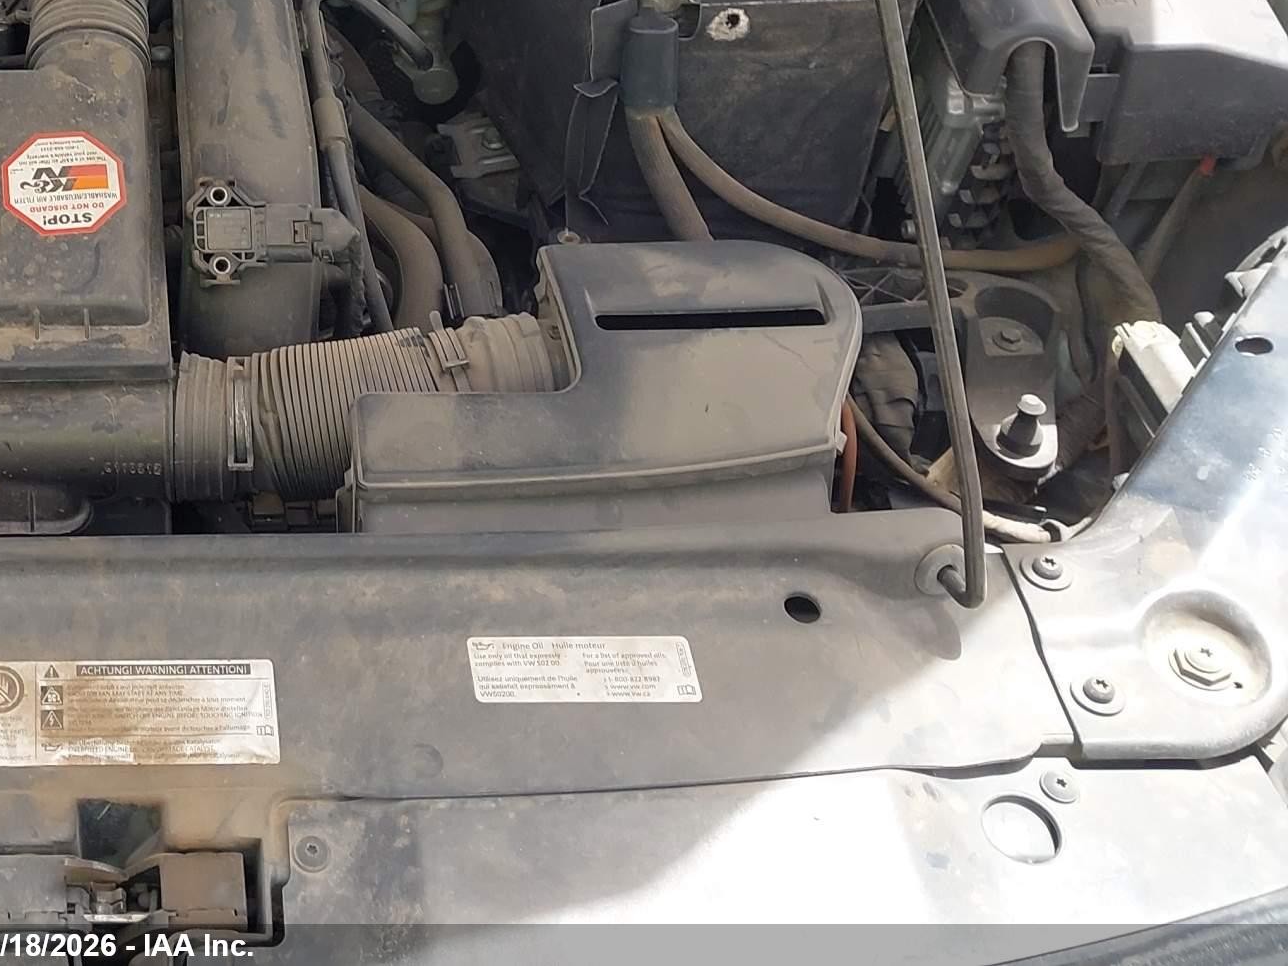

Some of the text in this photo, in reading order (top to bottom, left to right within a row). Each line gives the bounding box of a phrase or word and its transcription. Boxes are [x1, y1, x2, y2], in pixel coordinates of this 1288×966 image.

[14, 196, 35, 204] FILTER
[50, 192, 117, 202] WASHABLE/REUSABLE
[30, 204, 68, 213] DISCARD
[43, 213, 92, 225] STOP!
[502, 642, 530, 651] Engine
[621, 652, 652, 661] approved
[475, 661, 505, 669] complies
[81, 665, 247, 675] ACHTUNG! WARNING! ATTENTION!
[504, 676, 545, 684] uniquement
